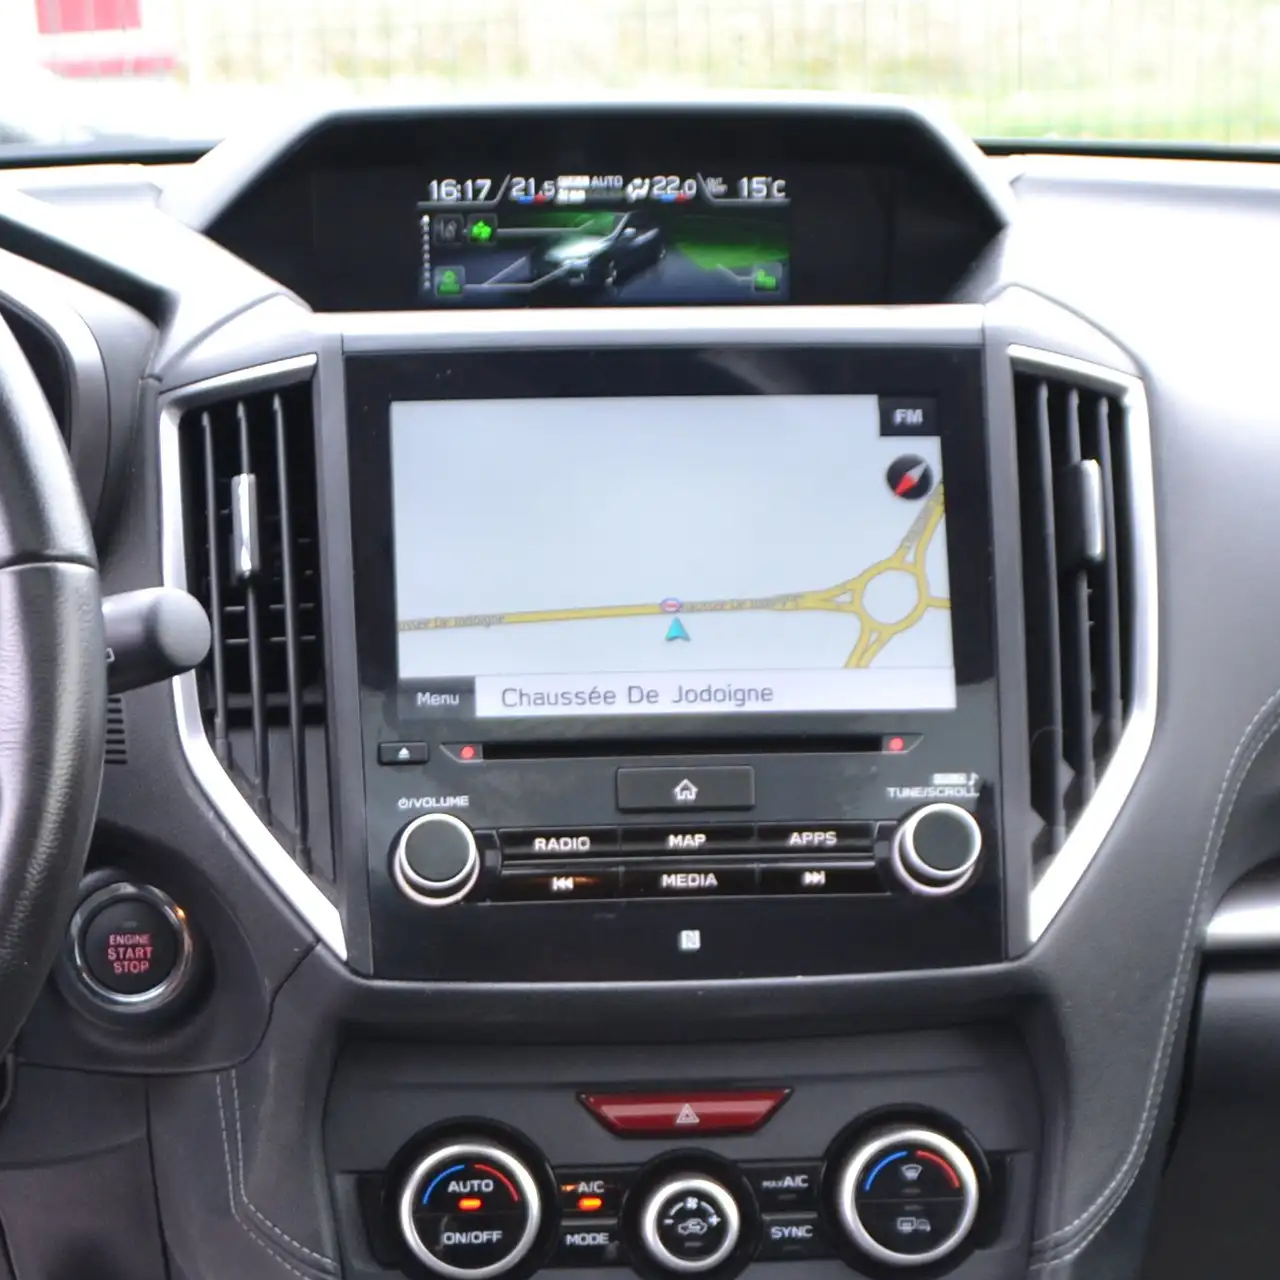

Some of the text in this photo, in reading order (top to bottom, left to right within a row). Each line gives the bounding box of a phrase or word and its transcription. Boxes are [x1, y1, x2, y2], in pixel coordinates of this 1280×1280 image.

[509, 177, 556, 201] 21.5
[590, 175, 623, 188] AUTO
[651, 176, 697, 200] 22.0
[428, 178, 492, 201] 16:17
[894, 408, 924, 426] FM
[417, 691, 460, 706] Menu
[501, 684, 774, 708] Chaussée De Jodoigne
[886, 785, 980, 799] TUNE/SCROLL
[533, 836, 591, 851] RADIO
[668, 833, 707, 848] MAP
[789, 831, 837, 847] APPS
[661, 872, 719, 888] MEDIA
[109, 933, 150, 945] ENGINE
[107, 946, 154, 960] START
[113, 960, 149, 973] STOP
[447, 1179, 494, 1193] AUTO
[577, 1180, 605, 1193] A/C
[443, 1230, 503, 1246] ON/OFF
[565, 1232, 610, 1246] MODE
[770, 1225, 814, 1240] SYNC
